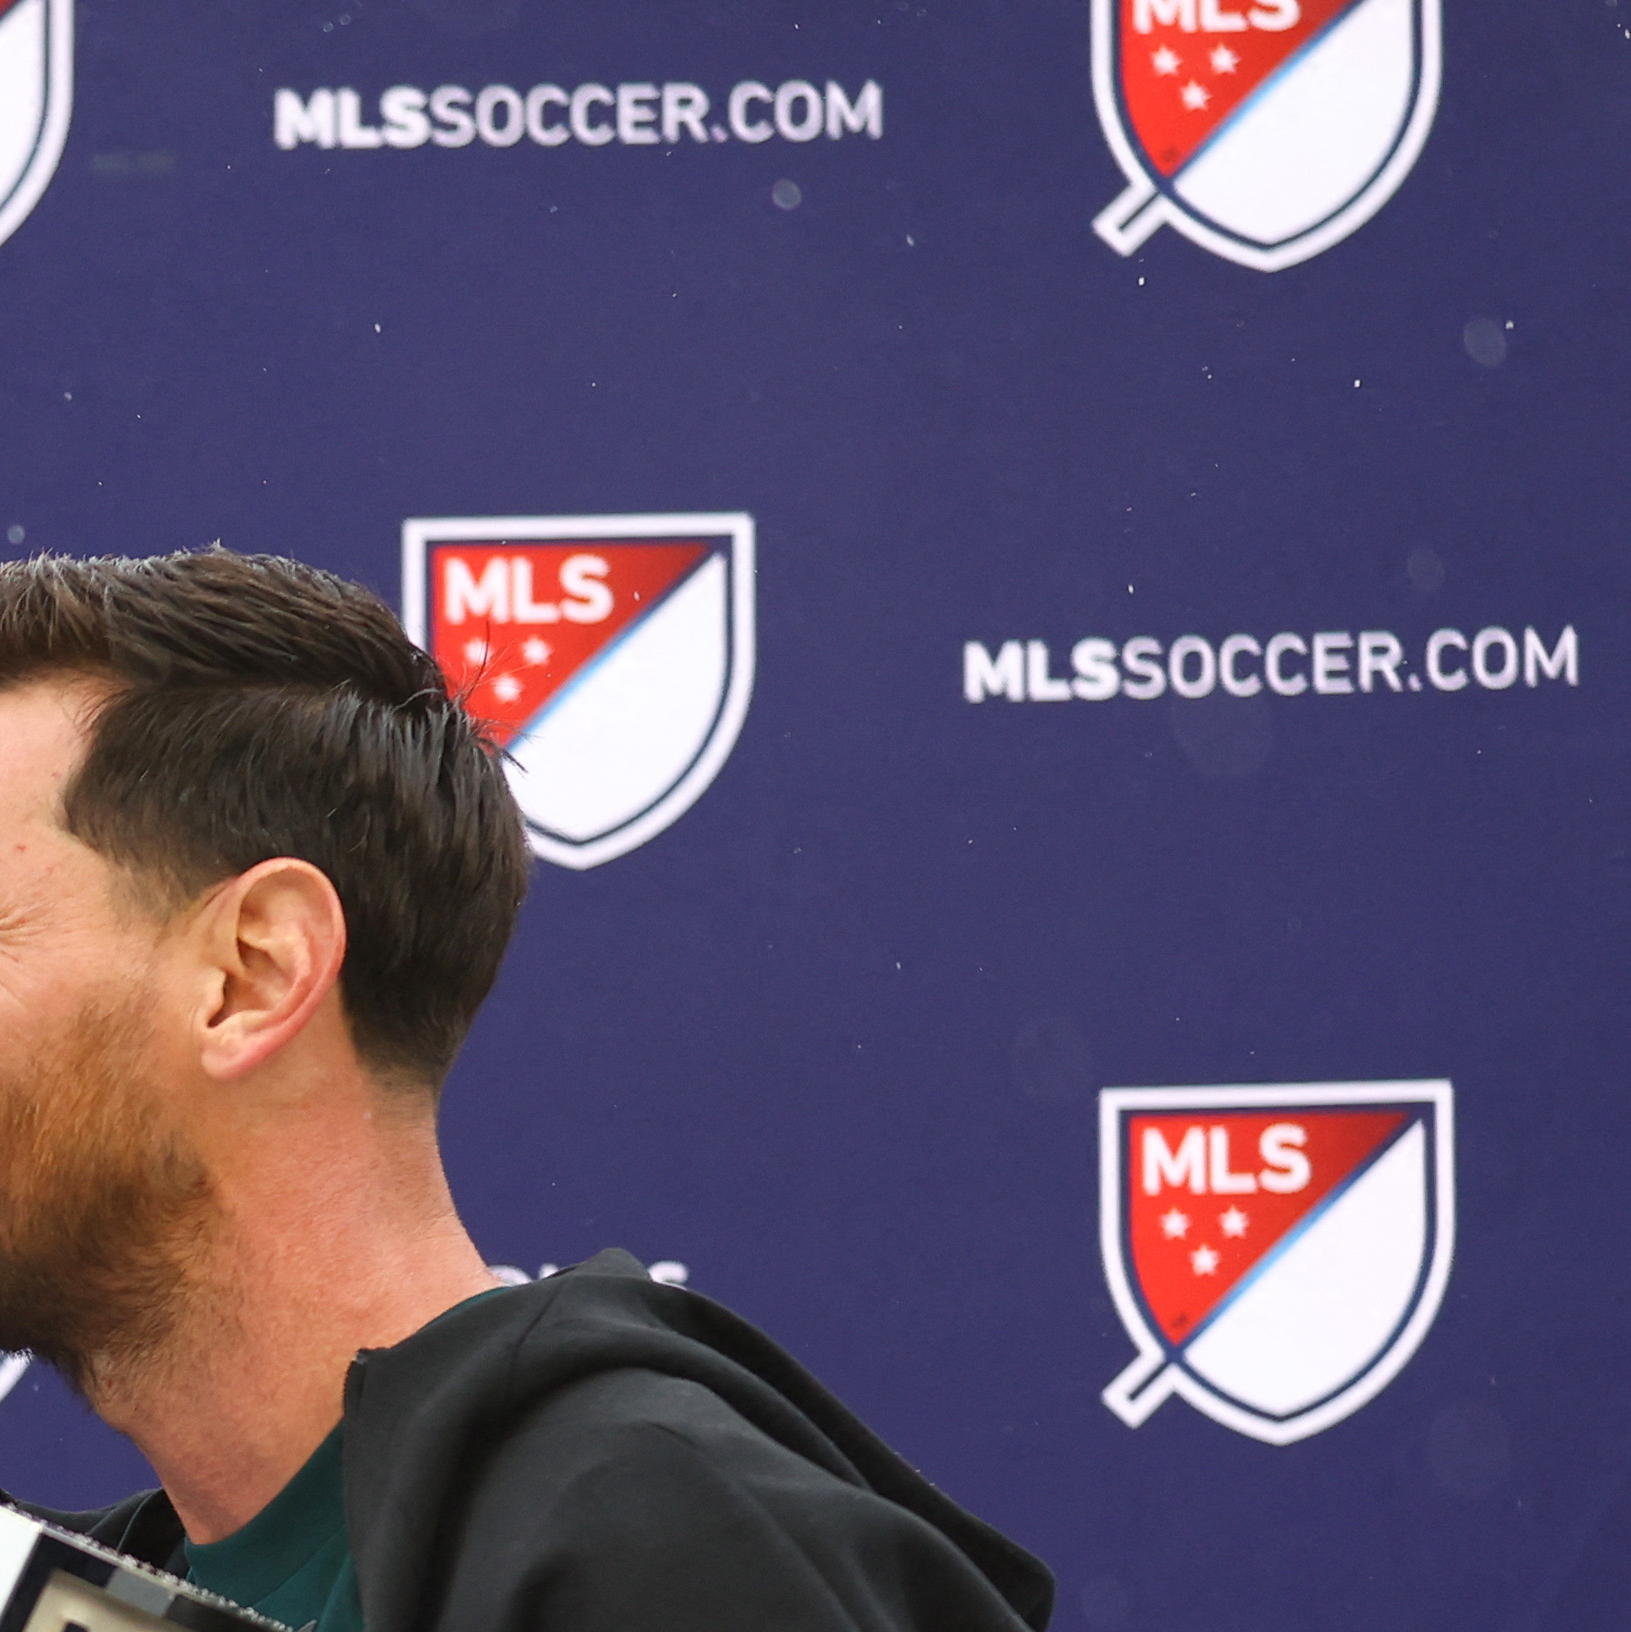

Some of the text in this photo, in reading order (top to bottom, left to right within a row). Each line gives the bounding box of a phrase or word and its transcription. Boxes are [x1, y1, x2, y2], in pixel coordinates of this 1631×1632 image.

[275, 80, 882, 149] MLSSOCCER.COM
[444, 554, 613, 624] MLS
[964, 626, 1577, 702] MLSSOCCER.COM
[1142, 1124, 1311, 1196] MLS
